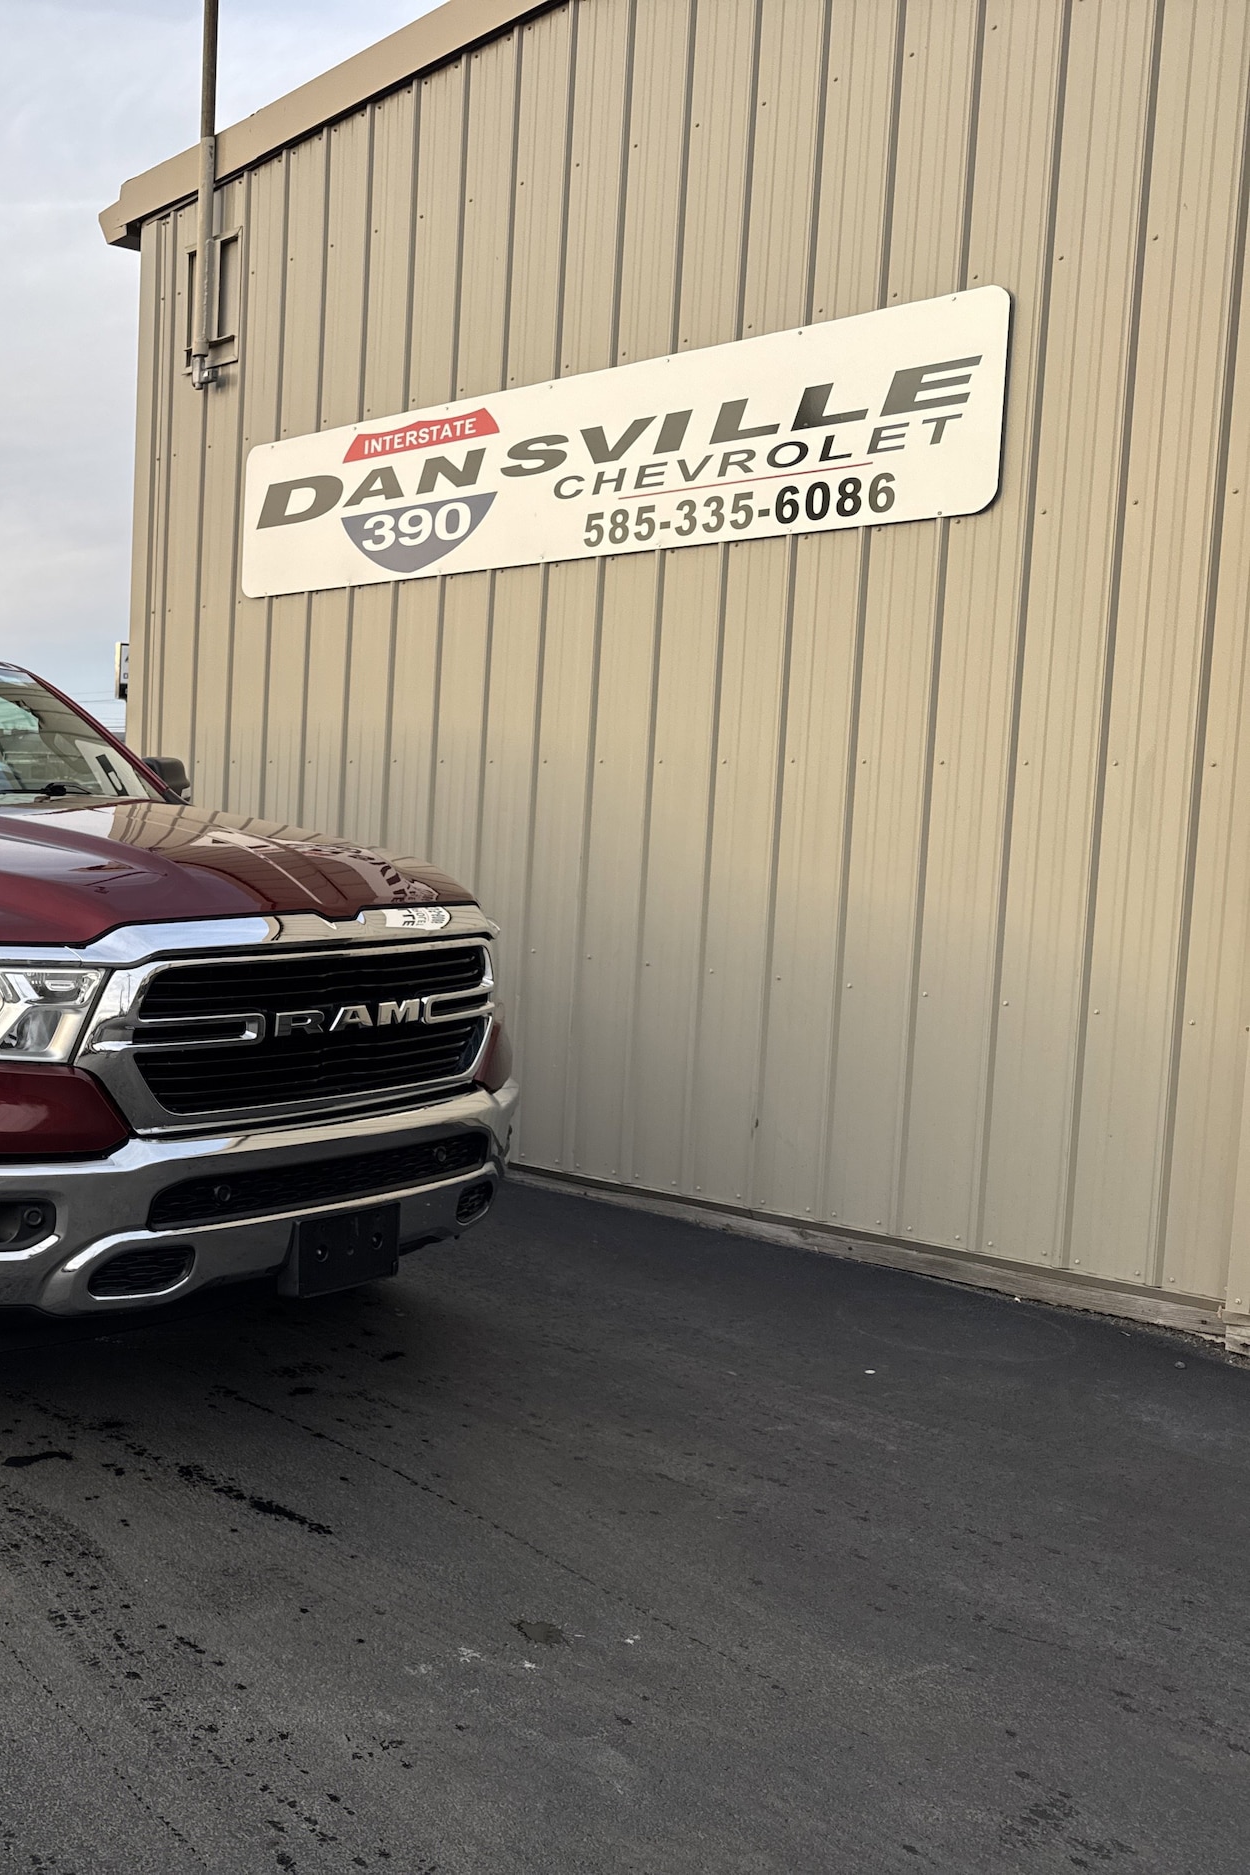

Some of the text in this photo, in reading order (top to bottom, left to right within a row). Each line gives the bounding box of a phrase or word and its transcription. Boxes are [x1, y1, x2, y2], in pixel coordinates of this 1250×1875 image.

[256, 355, 983, 530] DANSVILLE
[363, 417, 477, 455] INTERSTATE
[553, 413, 963, 500] CHEVROLET
[361, 501, 472, 552] 390
[583, 472, 896, 548] 585-335-6086
[275, 998, 420, 1037] RAM
